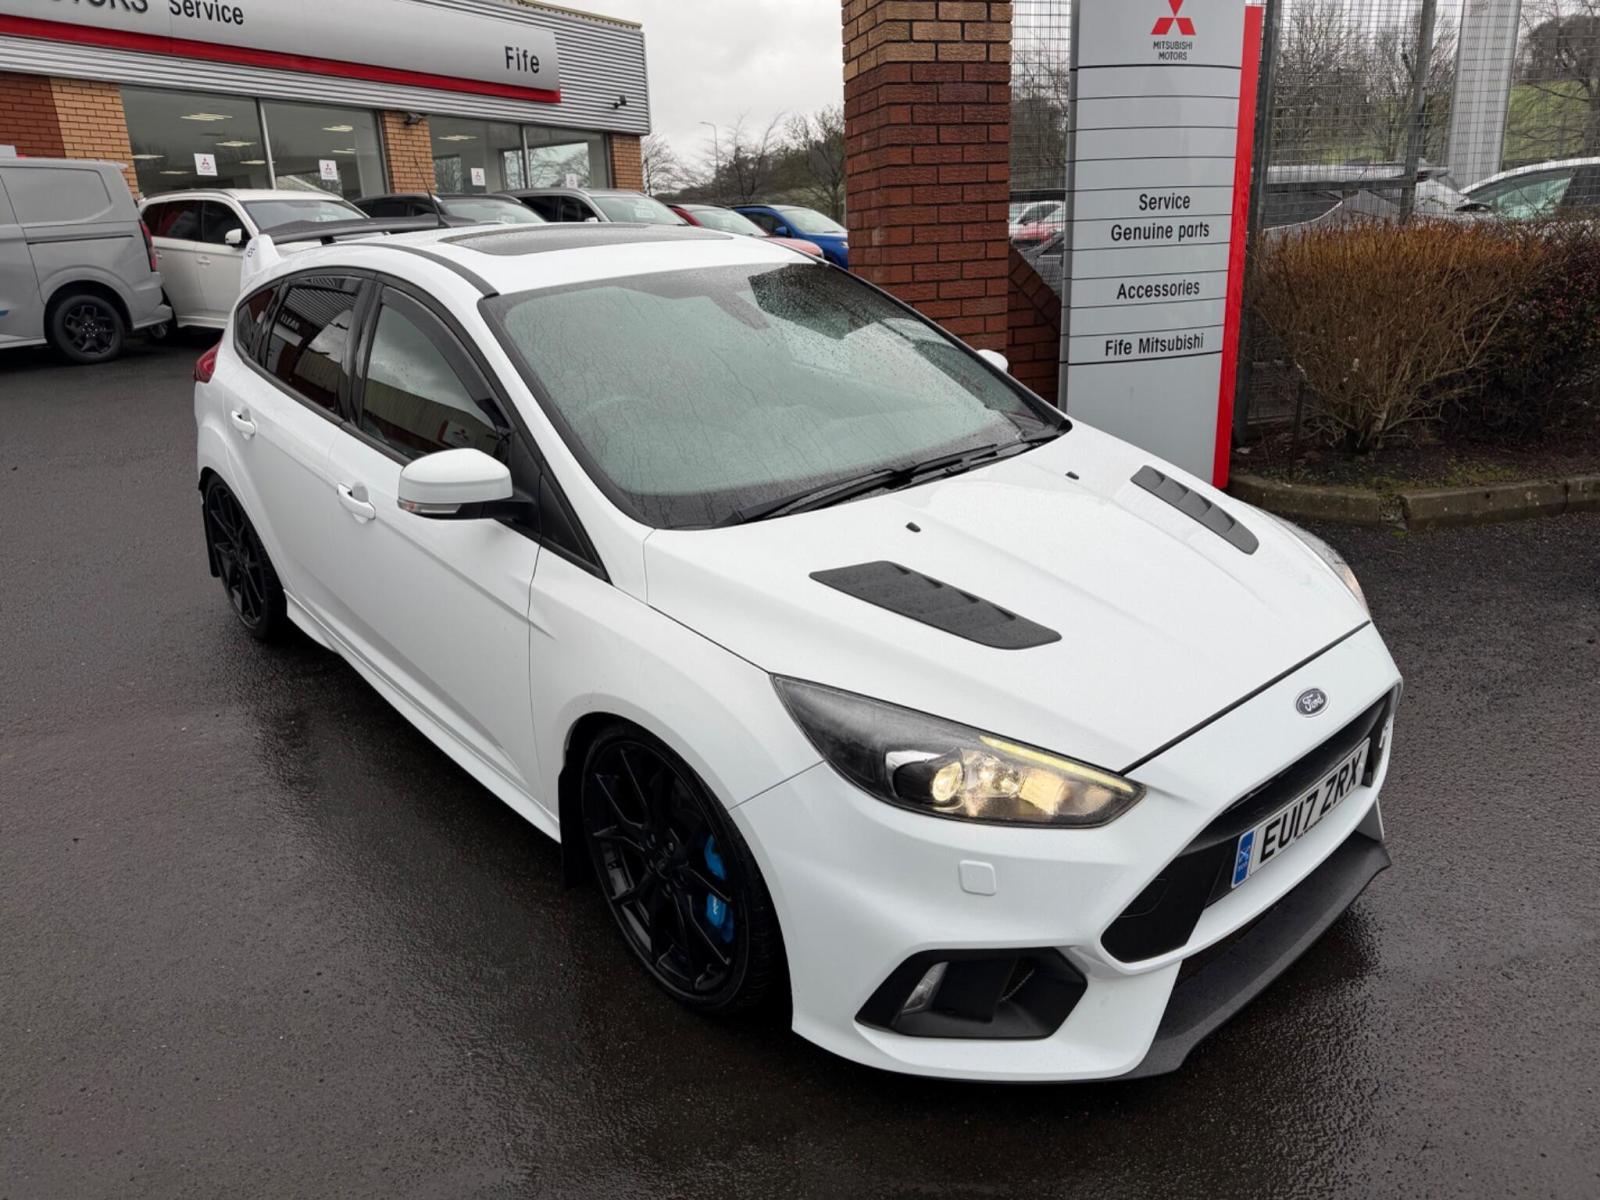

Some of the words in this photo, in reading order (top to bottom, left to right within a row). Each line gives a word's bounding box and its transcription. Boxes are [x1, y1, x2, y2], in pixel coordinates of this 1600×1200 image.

[169, 0, 244, 25] Service
[1153, 41, 1192, 49] MITSUBISHI
[505, 46, 540, 74] Fife
[1159, 52, 1187, 60] MOTORS
[1139, 192, 1190, 211] Service
[1111, 222, 1173, 241] Genuine
[1178, 221, 1209, 242] parts
[1116, 279, 1200, 300] Accessories
[1105, 339, 1132, 356] Fife
[1139, 333, 1204, 354] Mitsubishi
[1302, 693, 1324, 711] Ford
[1260, 788, 1319, 863] EU17
[1320, 751, 1362, 816] ZRX
